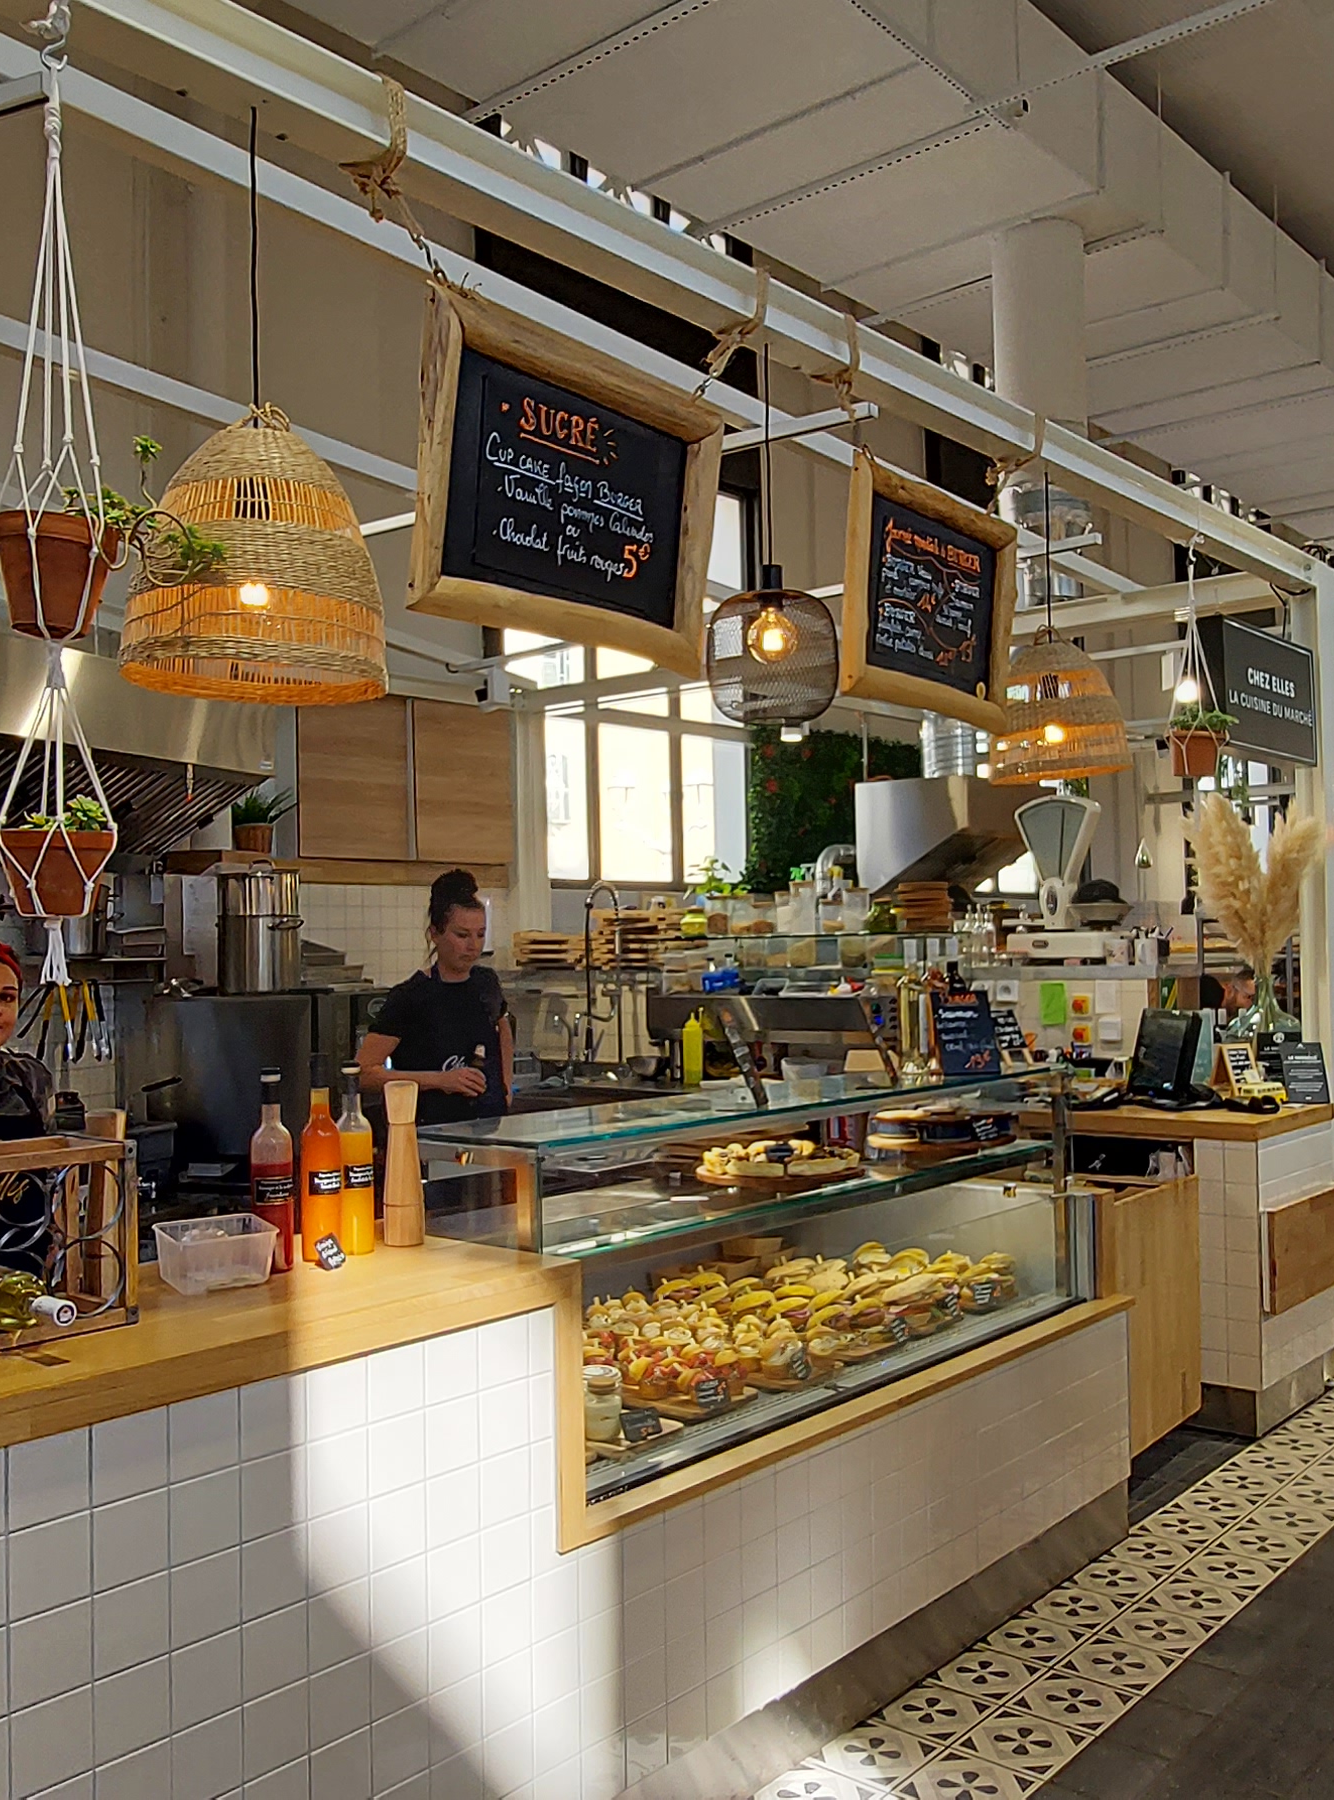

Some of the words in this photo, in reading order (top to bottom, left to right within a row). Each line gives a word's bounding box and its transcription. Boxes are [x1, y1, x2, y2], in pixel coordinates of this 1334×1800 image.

[519, 396, 600, 453] SUCRÉ
[1247, 666, 1271, 691] CHEZ
[1271, 676, 1296, 699] ELLES
[1228, 688, 1239, 704] LA
[1240, 691, 1272, 715] CUISINE
[1272, 701, 1283, 718] DU
[1284, 706, 1313, 728] MARCHÉ
